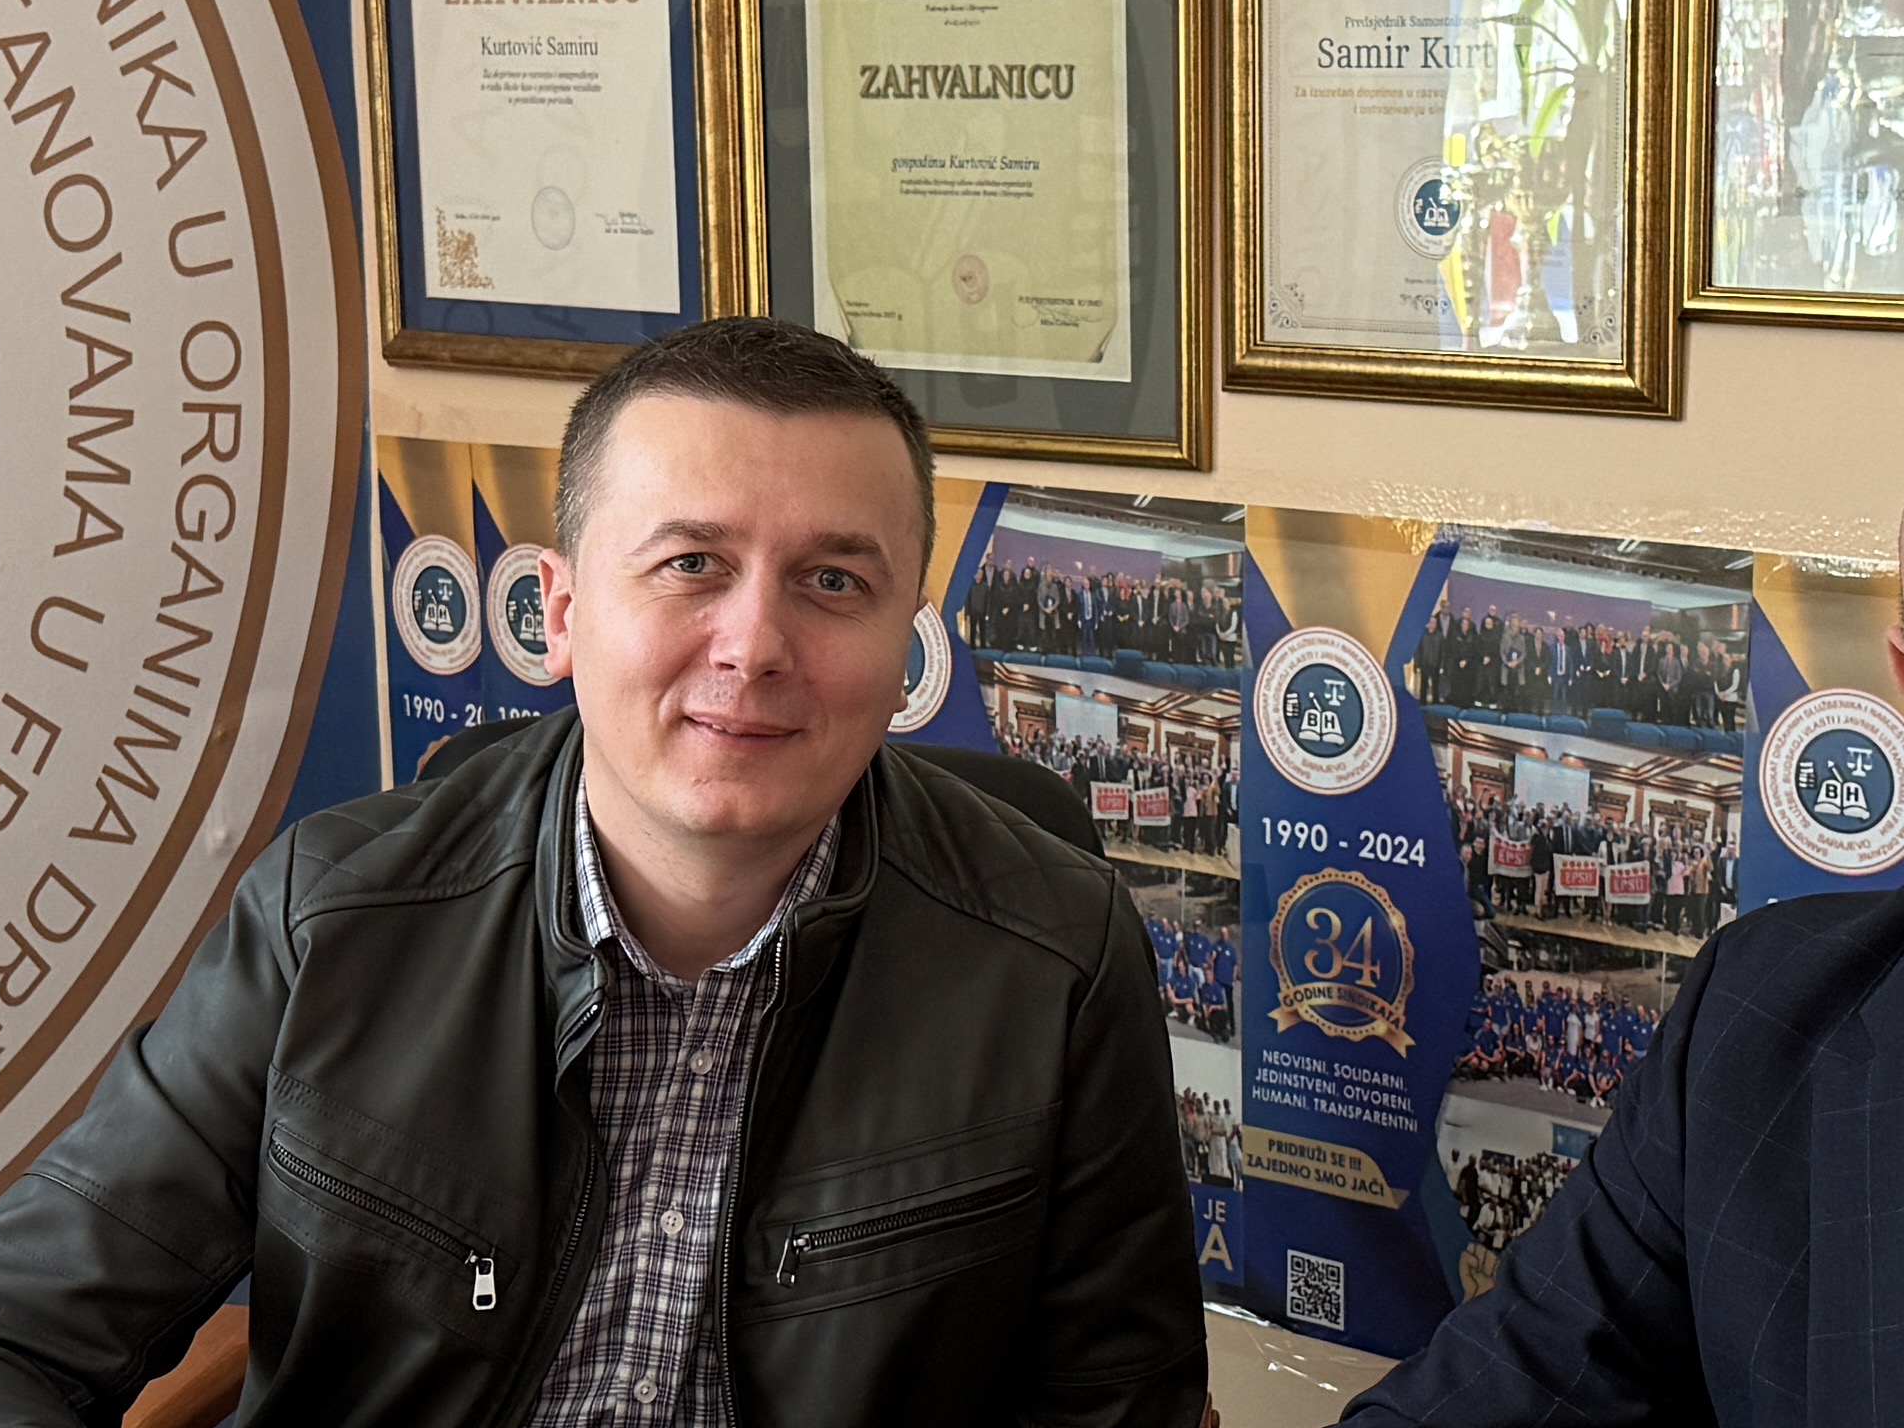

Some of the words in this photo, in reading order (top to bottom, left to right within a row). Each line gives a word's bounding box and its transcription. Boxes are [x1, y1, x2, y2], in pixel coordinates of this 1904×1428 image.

[481, 35, 543, 56] Kurtović
[546, 35, 599, 56] Samiru
[1317, 35, 1410, 70] Samir
[859, 63, 1076, 100] ZAHVALNICU
[164, 209, 244, 280] U
[63, 315, 244, 856] ORGANIMA
[21, 592, 104, 680] U
[402, 693, 445, 724] 1990
[1262, 817, 1329, 853] 1990
[1358, 830, 1426, 869] 2024
[1304, 907, 1382, 989] 34
[1282, 986, 1334, 1009] GODINE
[1313, 1098, 1419, 1133] TRANSPARENTNI
[1268, 1139, 1327, 1164] PRIDRUŽI
[1330, 1152, 1346, 1169] SE
[1246, 1153, 1313, 1181] ZAJEDNO
[1314, 1167, 1347, 1189] SMO
[1351, 1179, 1385, 1197] JAČI
